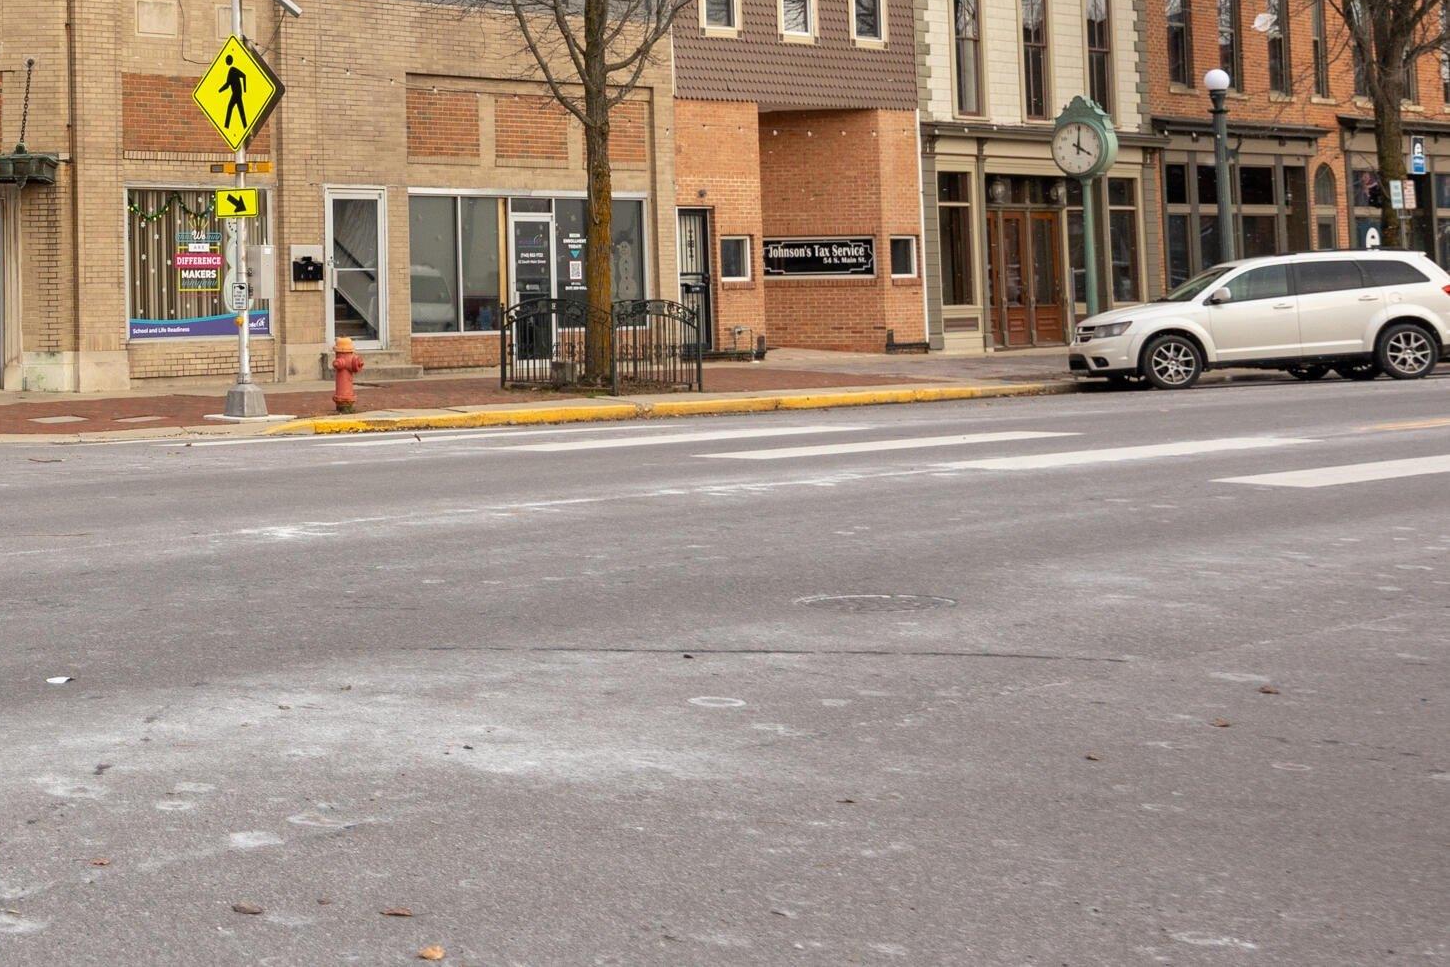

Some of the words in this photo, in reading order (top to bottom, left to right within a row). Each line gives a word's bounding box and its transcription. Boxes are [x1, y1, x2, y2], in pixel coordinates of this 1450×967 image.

[192, 229, 206, 240] We
[768, 245, 812, 258] Johnson's
[813, 245, 830, 257] Tax
[831, 244, 865, 257] Service
[176, 256, 222, 265] DIFFERENCE
[181, 269, 217, 279] MAKERS
